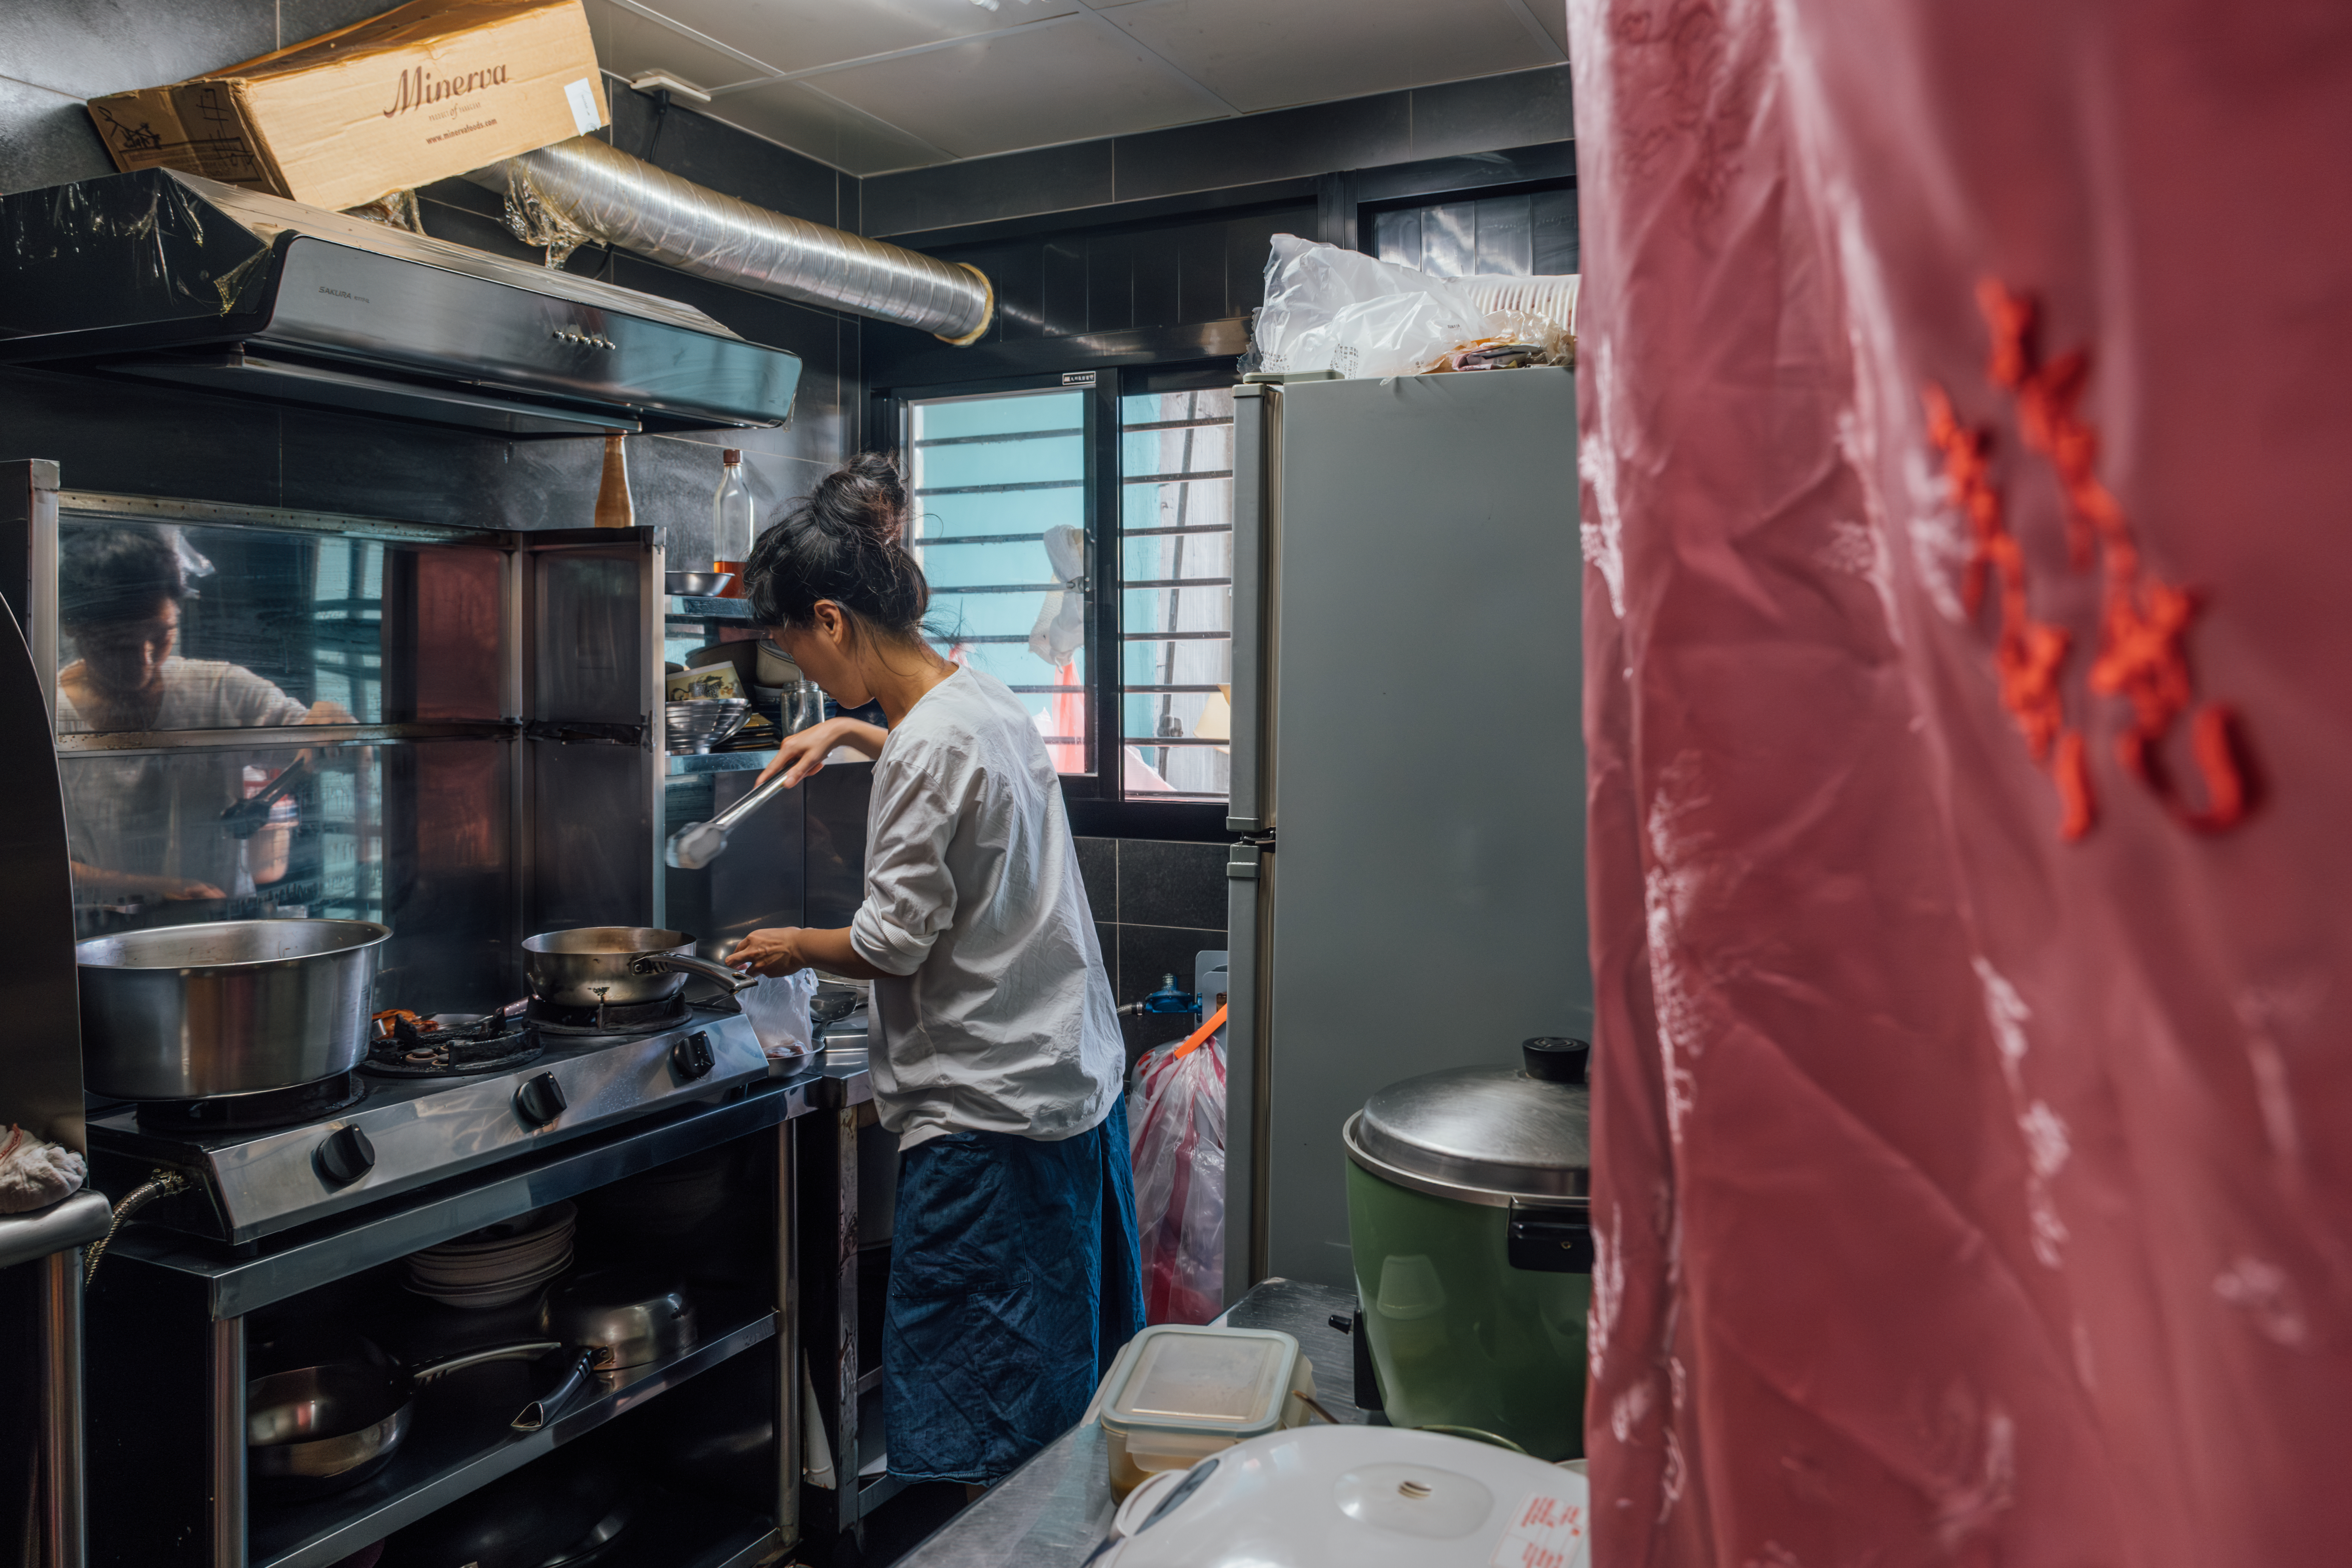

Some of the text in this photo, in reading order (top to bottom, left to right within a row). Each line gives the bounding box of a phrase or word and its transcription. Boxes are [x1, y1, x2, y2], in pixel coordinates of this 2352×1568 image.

[384, 64, 508, 118] Minerva
[450, 103, 459, 119] of
[426, 118, 498, 145] www.minervafoods.com
[318, 286, 351, 300] SAKURA
